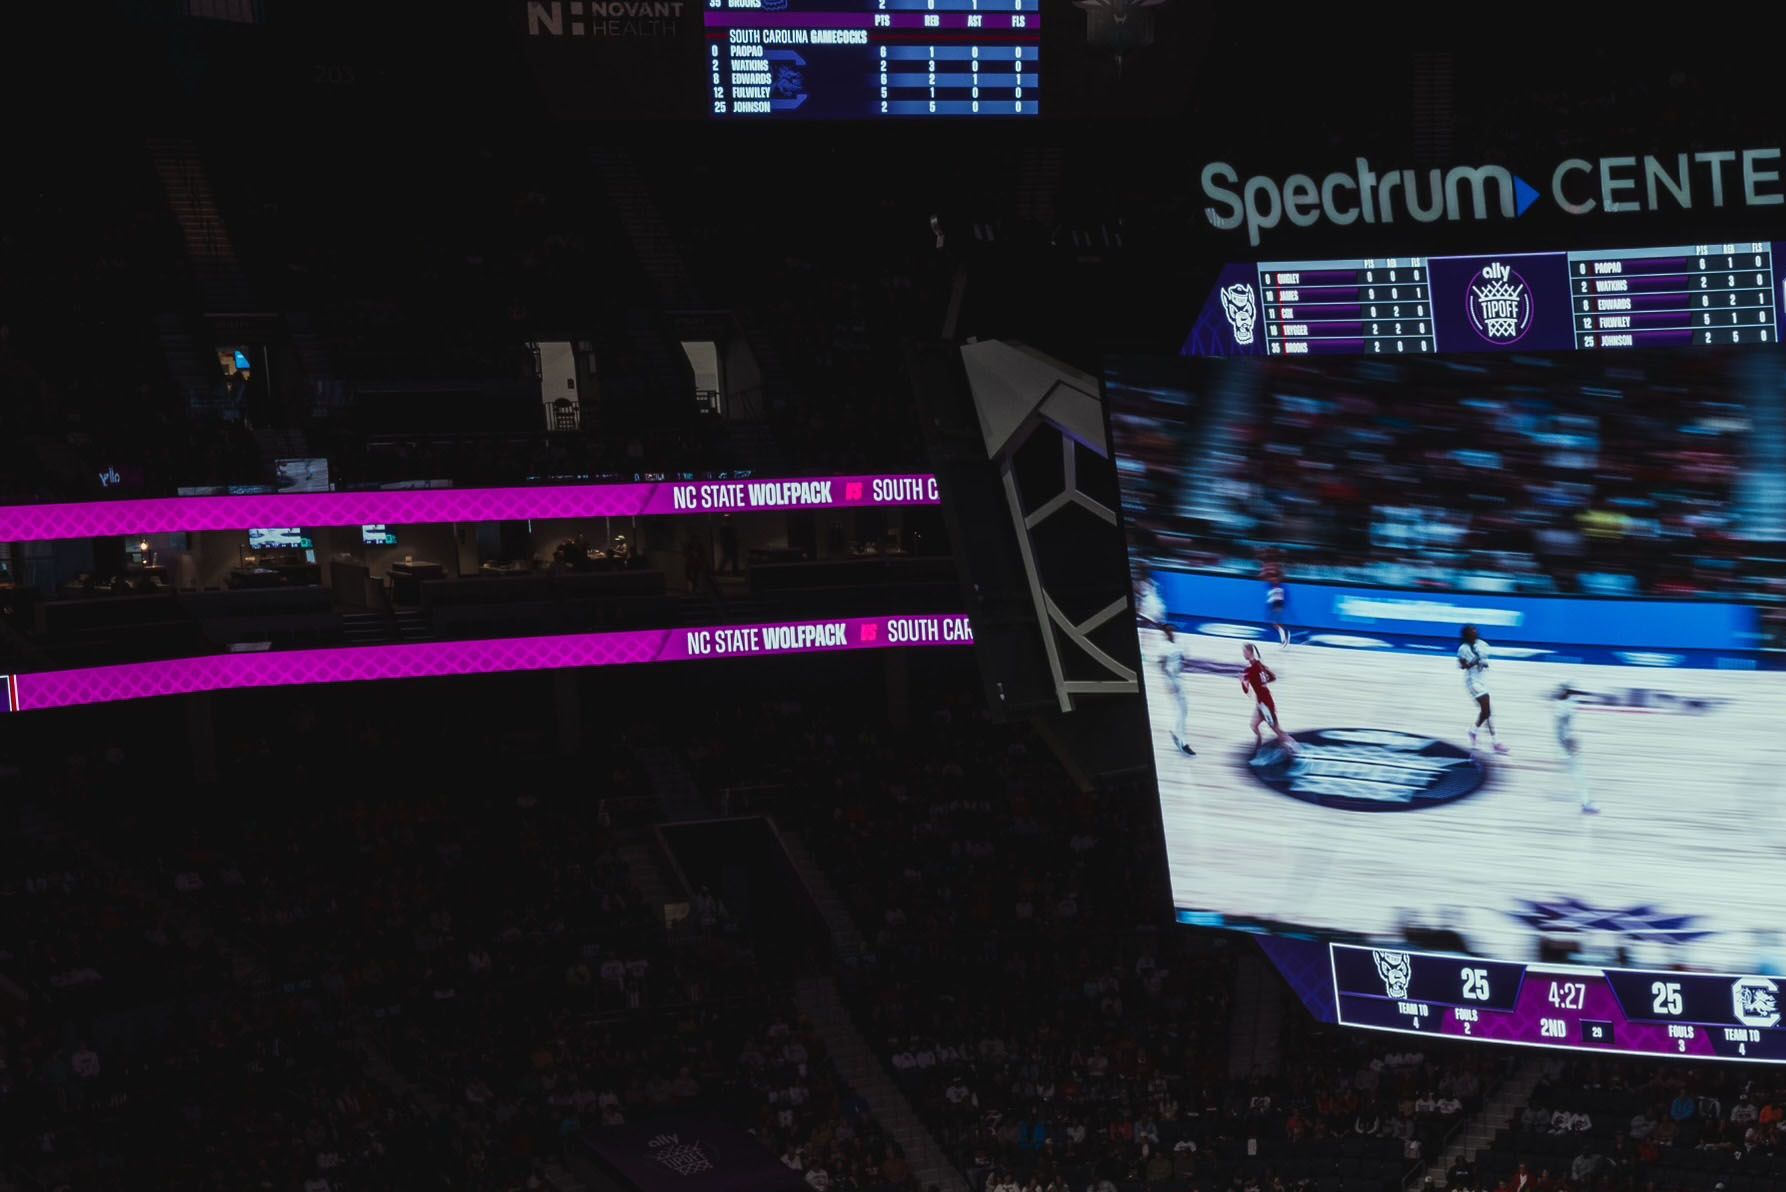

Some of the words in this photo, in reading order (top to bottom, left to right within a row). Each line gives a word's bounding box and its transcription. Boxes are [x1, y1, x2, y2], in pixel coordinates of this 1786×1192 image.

[591, 2, 685, 17] NOVANT
[874, 14, 891, 27] PTS
[924, 14, 940, 27] REB
[967, 15, 982, 27] AST
[1011, 15, 1026, 27] FLS
[592, 19, 676, 37] HEALTH
[729, 29, 760, 44] SOUTH
[762, 29, 809, 44] CAROLINA
[810, 29, 868, 44] GAMECOCKS
[711, 45, 718, 57] 0
[730, 45, 763, 57] PAOPAO
[880, 46, 887, 58] 6
[929, 46, 934, 58] 1
[972, 46, 978, 58] 0
[1015, 46, 1022, 58] 0
[712, 59, 719, 71] 2
[731, 60, 769, 71] WATKINS
[880, 60, 887, 72] 2
[929, 60, 935, 72] 3
[972, 60, 978, 72] 0
[1015, 60, 1022, 72] 0
[713, 73, 719, 84] 8
[731, 73, 772, 85] EDWARDS
[880, 73, 887, 85] 6
[929, 73, 935, 85] 2
[972, 73, 978, 85] 1
[1016, 73, 1021, 85] 1
[713, 87, 724, 98] 12
[732, 87, 771, 98] FULWILEY
[881, 87, 887, 98] 5
[930, 87, 935, 98] 1
[972, 87, 978, 98] 0
[1015, 87, 1022, 98] 0
[714, 101, 726, 113] 25
[733, 101, 771, 113] JOHNSON
[881, 101, 888, 113] 2
[929, 101, 936, 113] 5
[972, 101, 979, 113] 0
[1015, 101, 1022, 113] 0
[1201, 157, 1515, 246] Spectrum
[1728, 257, 1733, 268] 1
[1482, 262, 1511, 282] ally
[1581, 281, 1588, 292] 2
[1700, 276, 1707, 288] 2
[1728, 275, 1735, 287] 3
[1730, 294, 1736, 306] 2
[1758, 293, 1764, 305] 1
[1393, 305, 1400, 317] 2
[1481, 300, 1518, 319] TIPOFF
[1583, 317, 1592, 329] 12
[1703, 313, 1710, 325] 5
[1732, 312, 1737, 324] 1
[1372, 323, 1379, 335] 2
[1395, 323, 1402, 335] 2
[1705, 331, 1712, 344] 2
[1374, 341, 1380, 352] 2
[673, 485, 697, 509] NC
[701, 483, 745, 508] STATE
[748, 481, 833, 507] WOLFPACK
[873, 478, 924, 501] SOUTH
[888, 618, 938, 643] SOUTH
[687, 631, 711, 655] NC
[715, 628, 759, 653] STATE
[762, 623, 847, 650] WOLFPACK
[1461, 967, 1490, 1001] 25
[1548, 981, 1586, 1010] 4:27
[1651, 981, 1683, 1015] 25
[1398, 1001, 1418, 1016] TEAM
[1418, 1003, 1429, 1017] TO
[1455, 1008, 1478, 1022] FOULS
[1413, 1017, 1419, 1029] 4
[1464, 1022, 1471, 1034] 2
[1540, 1018, 1566, 1038] 2ND
[1668, 1025, 1694, 1039] FOULS
[1724, 1028, 1748, 1042] TEAM
[1749, 1029, 1760, 1042] TO
[1678, 1039, 1685, 1052] 3
[1738, 1043, 1746, 1055] 4
[648, 1133, 679, 1148] ally
